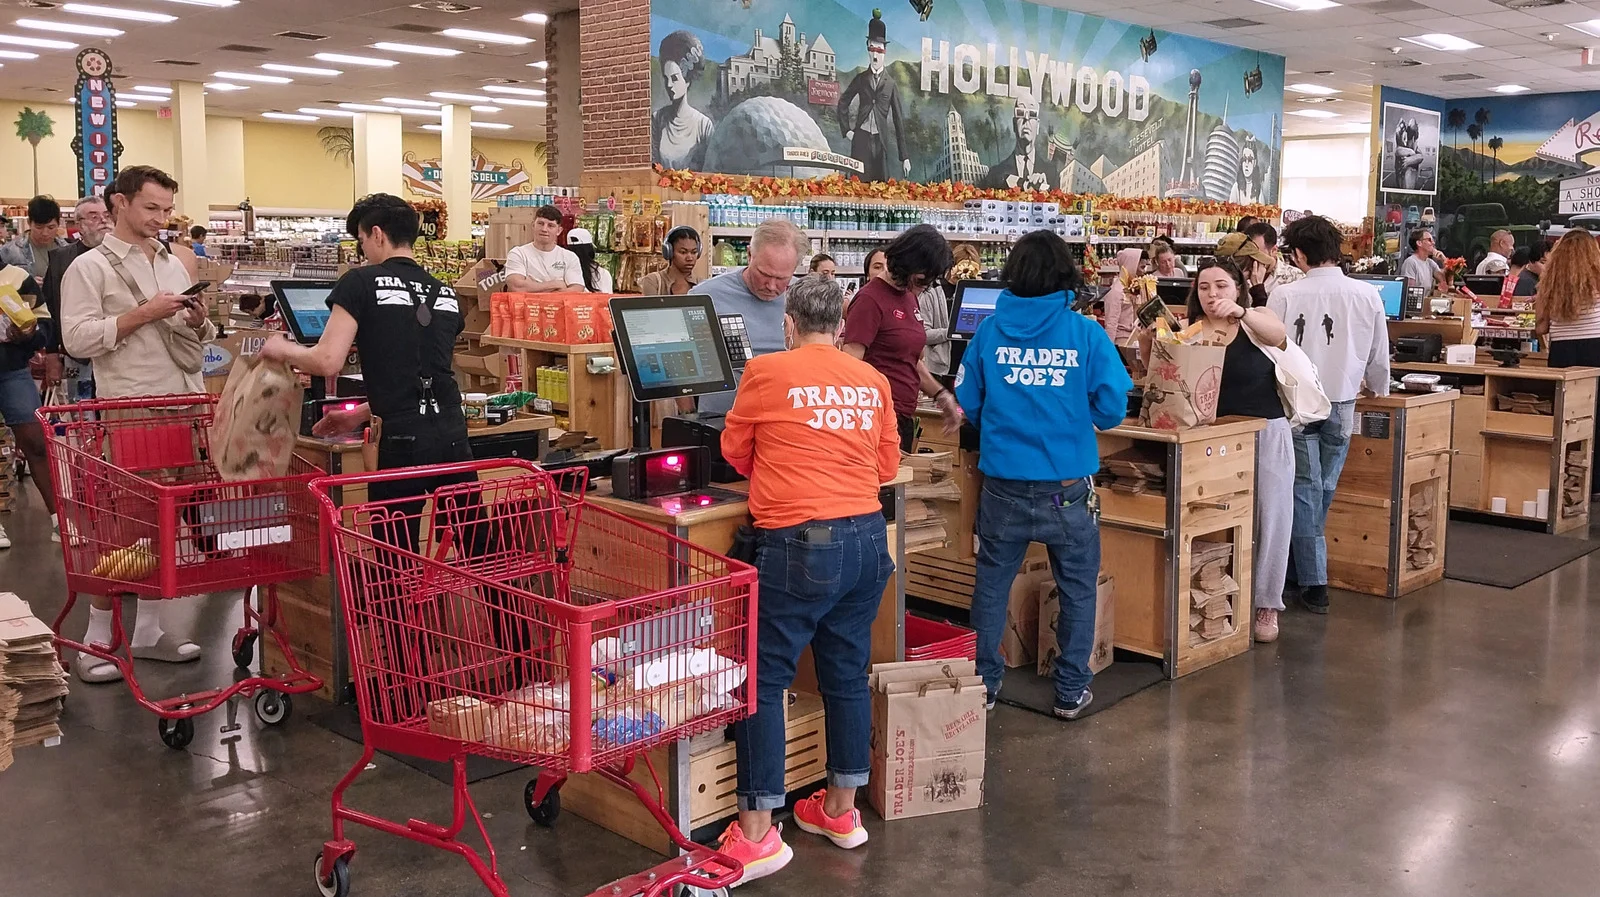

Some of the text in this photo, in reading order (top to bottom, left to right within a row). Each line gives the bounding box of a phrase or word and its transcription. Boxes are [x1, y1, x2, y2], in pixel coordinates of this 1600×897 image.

[920, 37, 1150, 122] HOLLYWOOD
[90, 79, 105, 125] NEW
[1134, 137, 1154, 155] HOTEL
[480, 172, 498, 182] DELI
[1566, 190, 1572, 200] A
[995, 347, 1080, 367] TRADER
[1004, 367, 1068, 387] JOE'S
[787, 386, 883, 409] TRADER
[806, 408, 875, 430] JOE'S
[894, 729, 906, 815] TRADER JOE'S
